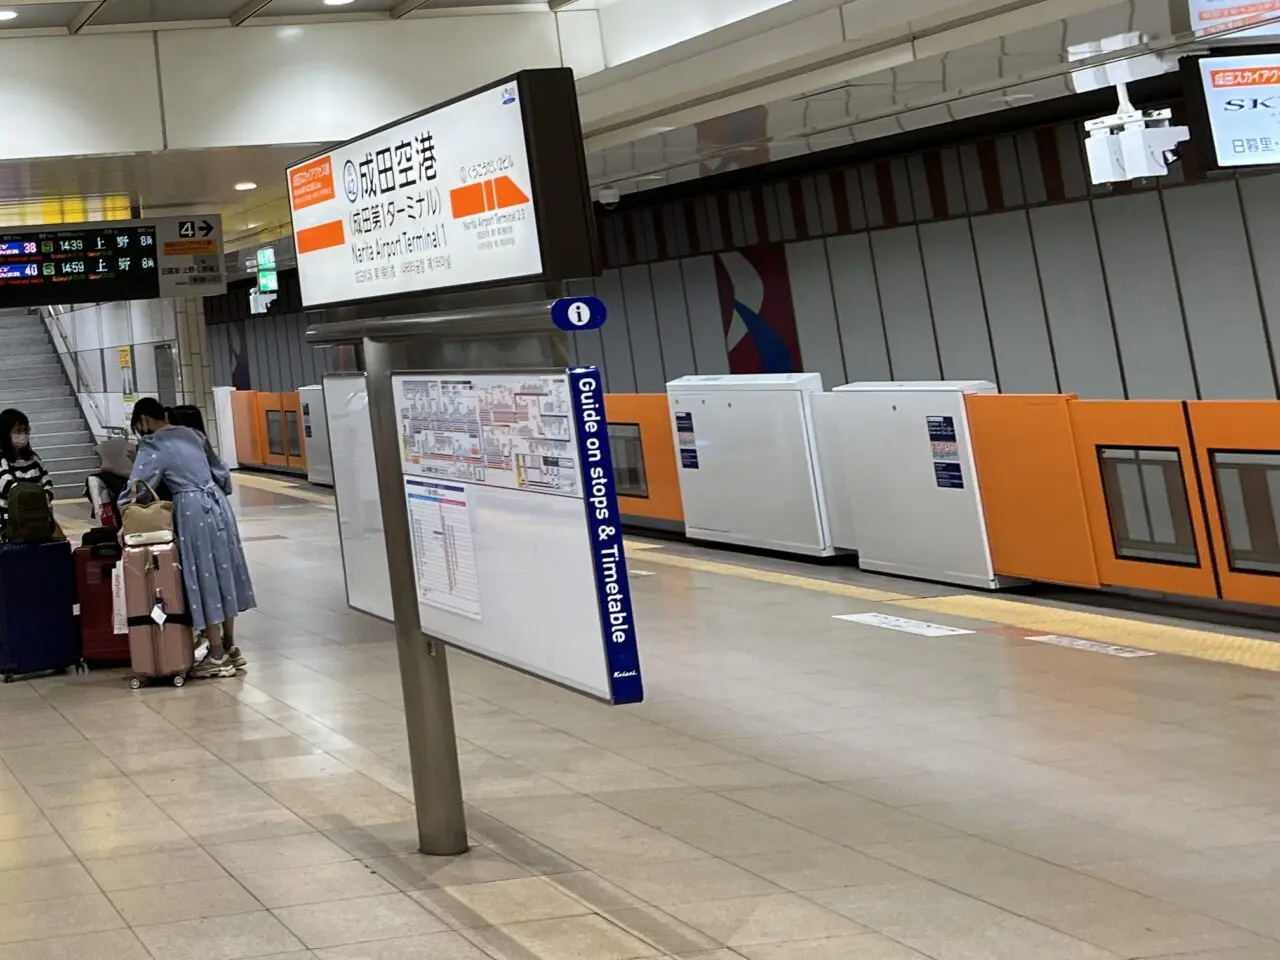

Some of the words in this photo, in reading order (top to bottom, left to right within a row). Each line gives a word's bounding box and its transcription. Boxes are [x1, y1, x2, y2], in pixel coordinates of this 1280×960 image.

[359, 130, 437, 199] 成田空港
[181, 223, 194, 237] 4
[352, 240, 374, 264] Narita
[376, 235, 402, 262] Airport
[402, 224, 441, 253] Terminal
[441, 223, 447, 247] 1
[24, 242, 37, 253] 38
[25, 264, 38, 276] 40
[579, 377, 601, 433] Guide
[586, 438, 601, 461] on
[590, 467, 609, 520] stops
[598, 525, 616, 541] &
[601, 544, 629, 643] Timetable
